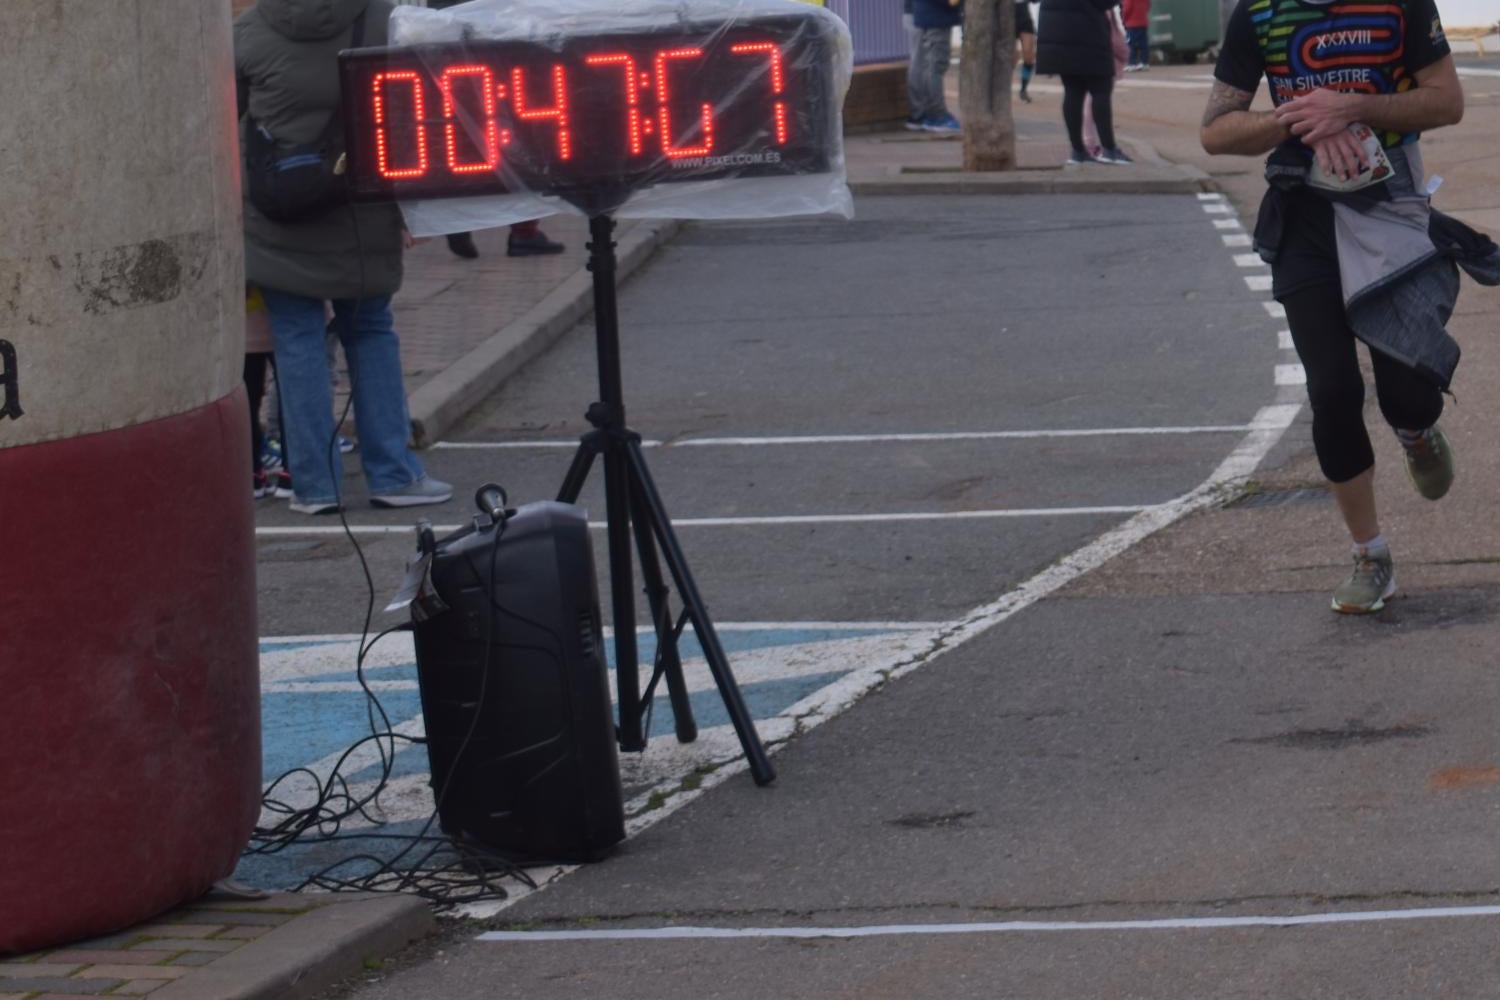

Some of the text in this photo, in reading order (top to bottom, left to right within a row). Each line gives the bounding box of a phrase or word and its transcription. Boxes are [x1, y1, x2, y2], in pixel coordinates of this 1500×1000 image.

[1316, 30, 1371, 50] XXXVIII
[1273, 68, 1371, 91] SAN SILVESTRE
[671, 151, 781, 169] WWW.PIXELCOM.ES
